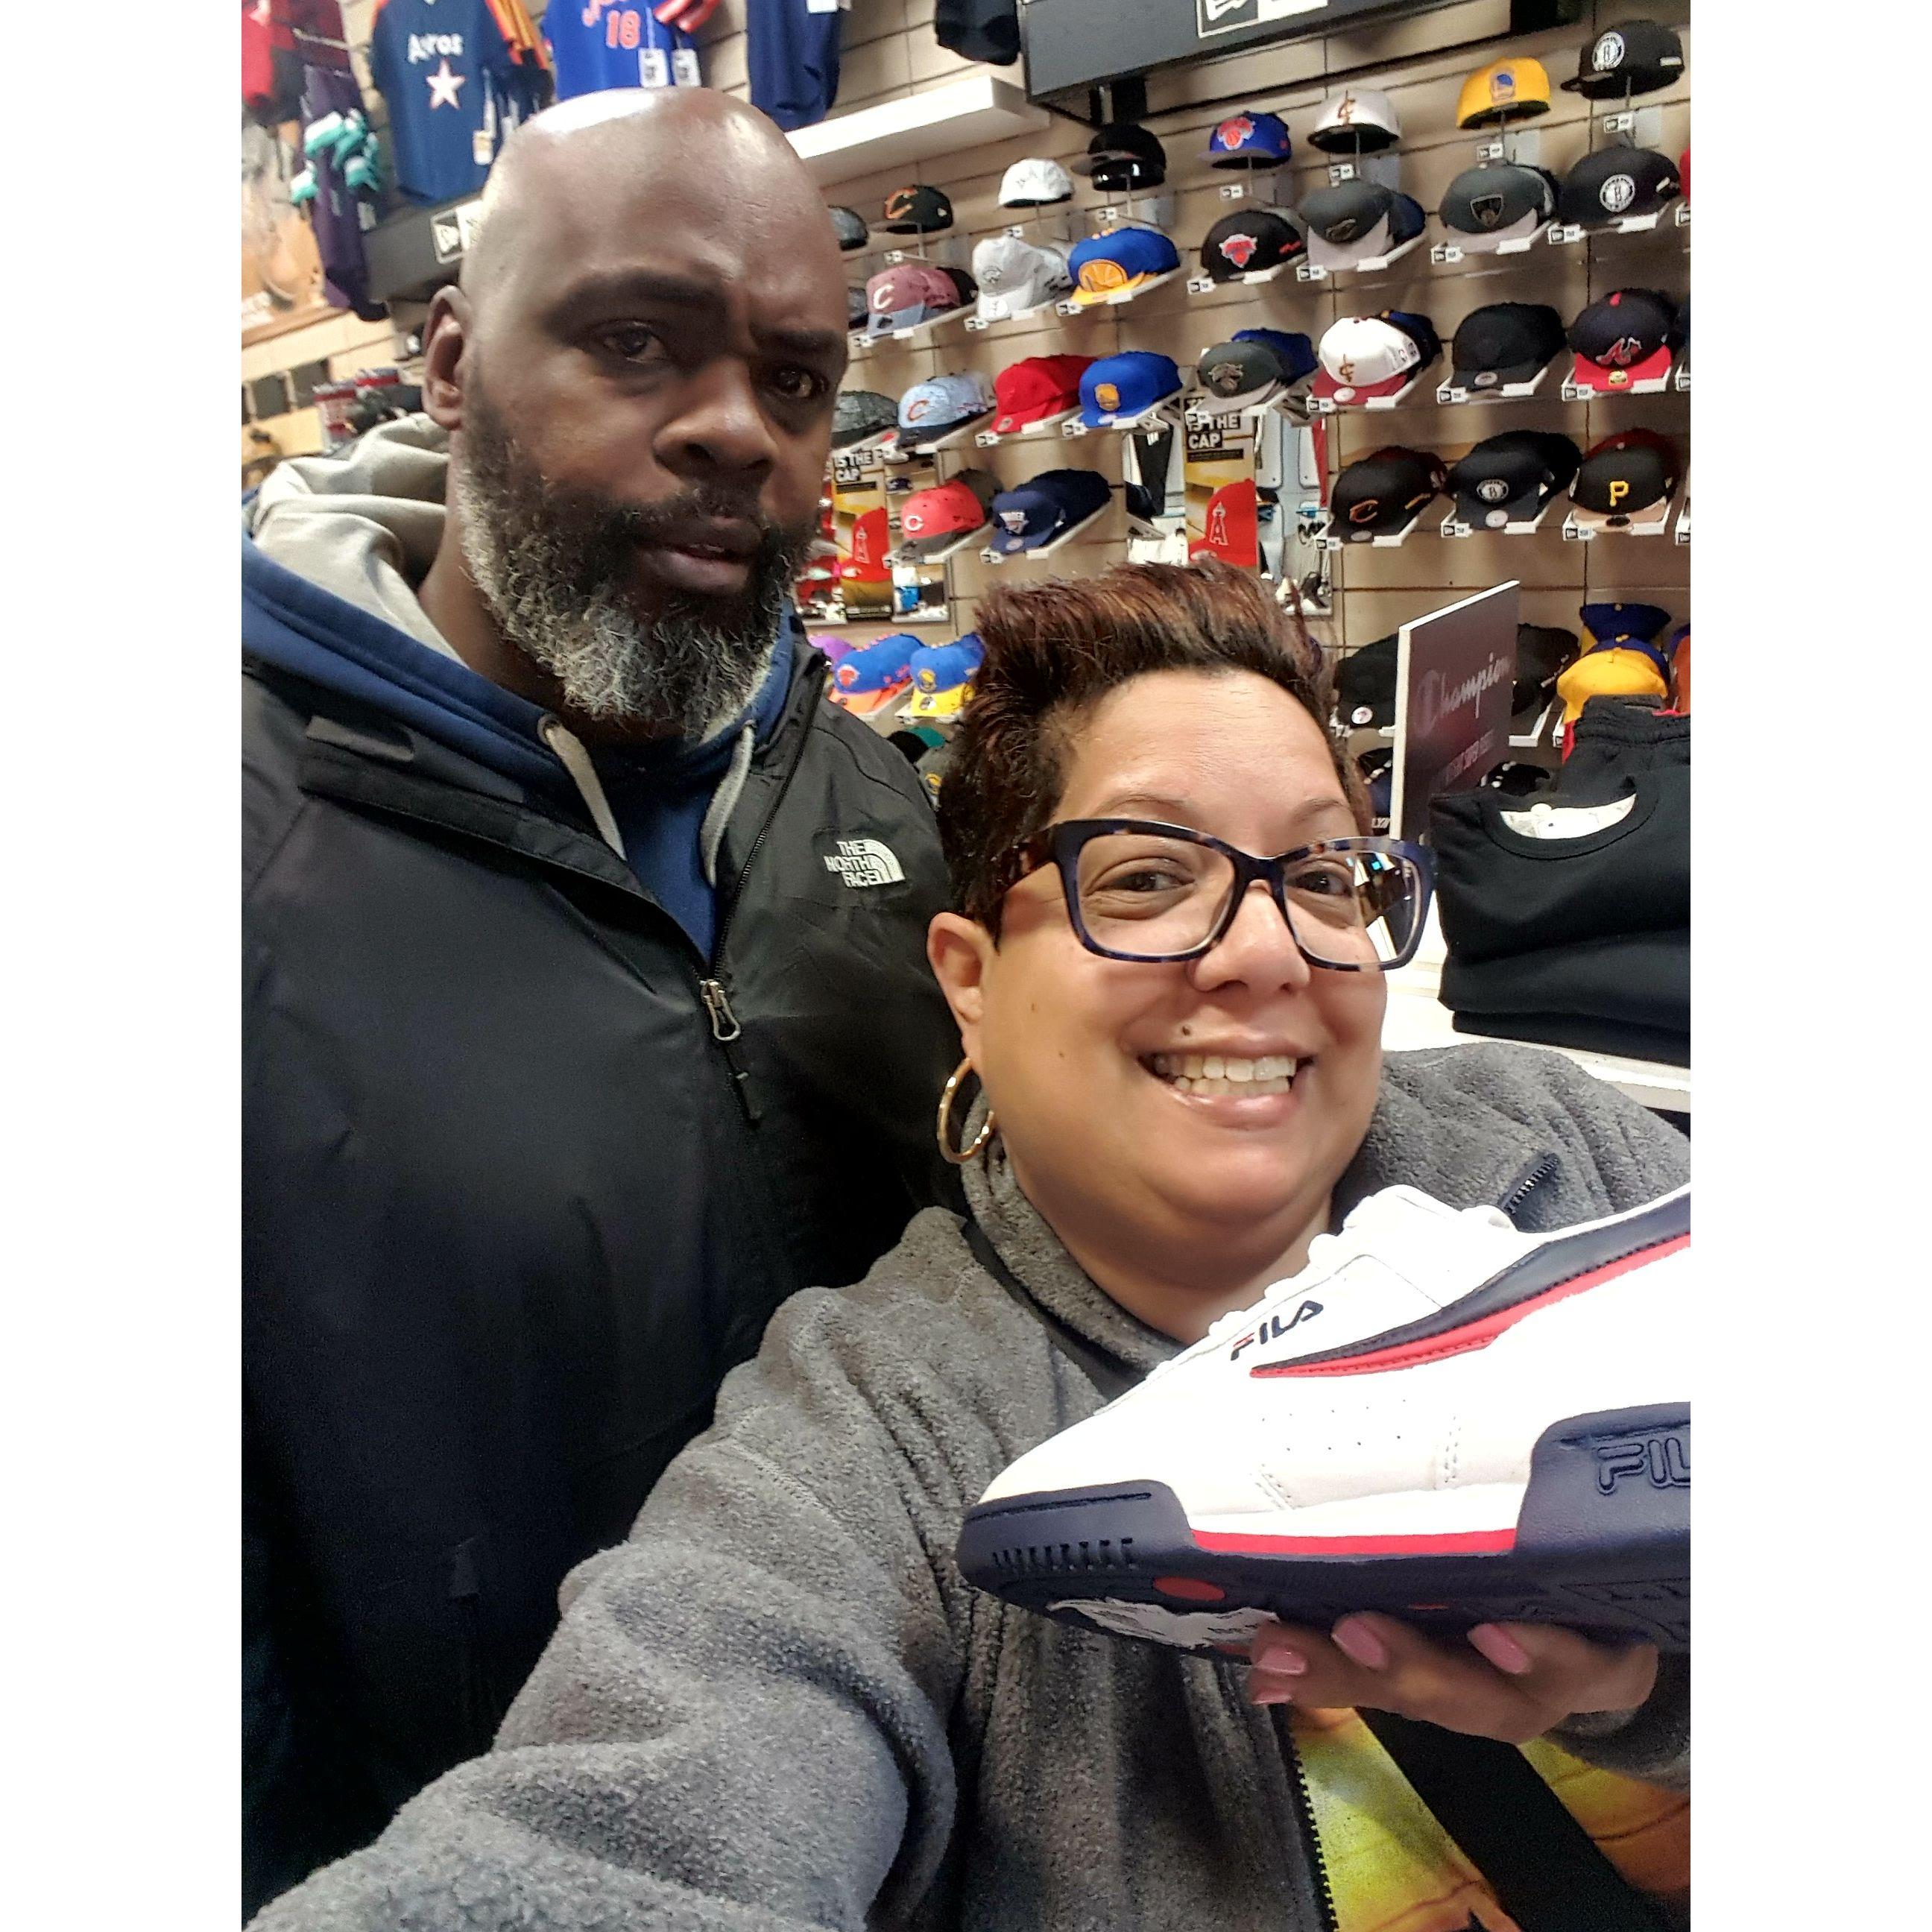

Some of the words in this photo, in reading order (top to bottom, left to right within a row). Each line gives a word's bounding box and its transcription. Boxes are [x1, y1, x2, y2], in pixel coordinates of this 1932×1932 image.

[606, 10, 641, 49] 18
[874, 285, 894, 309] C
[908, 400, 929, 422] C
[1188, 432, 1221, 449] CAP
[1609, 480, 1629, 508] P
[904, 515, 924, 531] C
[836, 840, 865, 856] THE
[824, 855, 872, 872] NORTH
[842, 870, 880, 888] FACE
[1231, 1300, 1324, 1361] FILA
